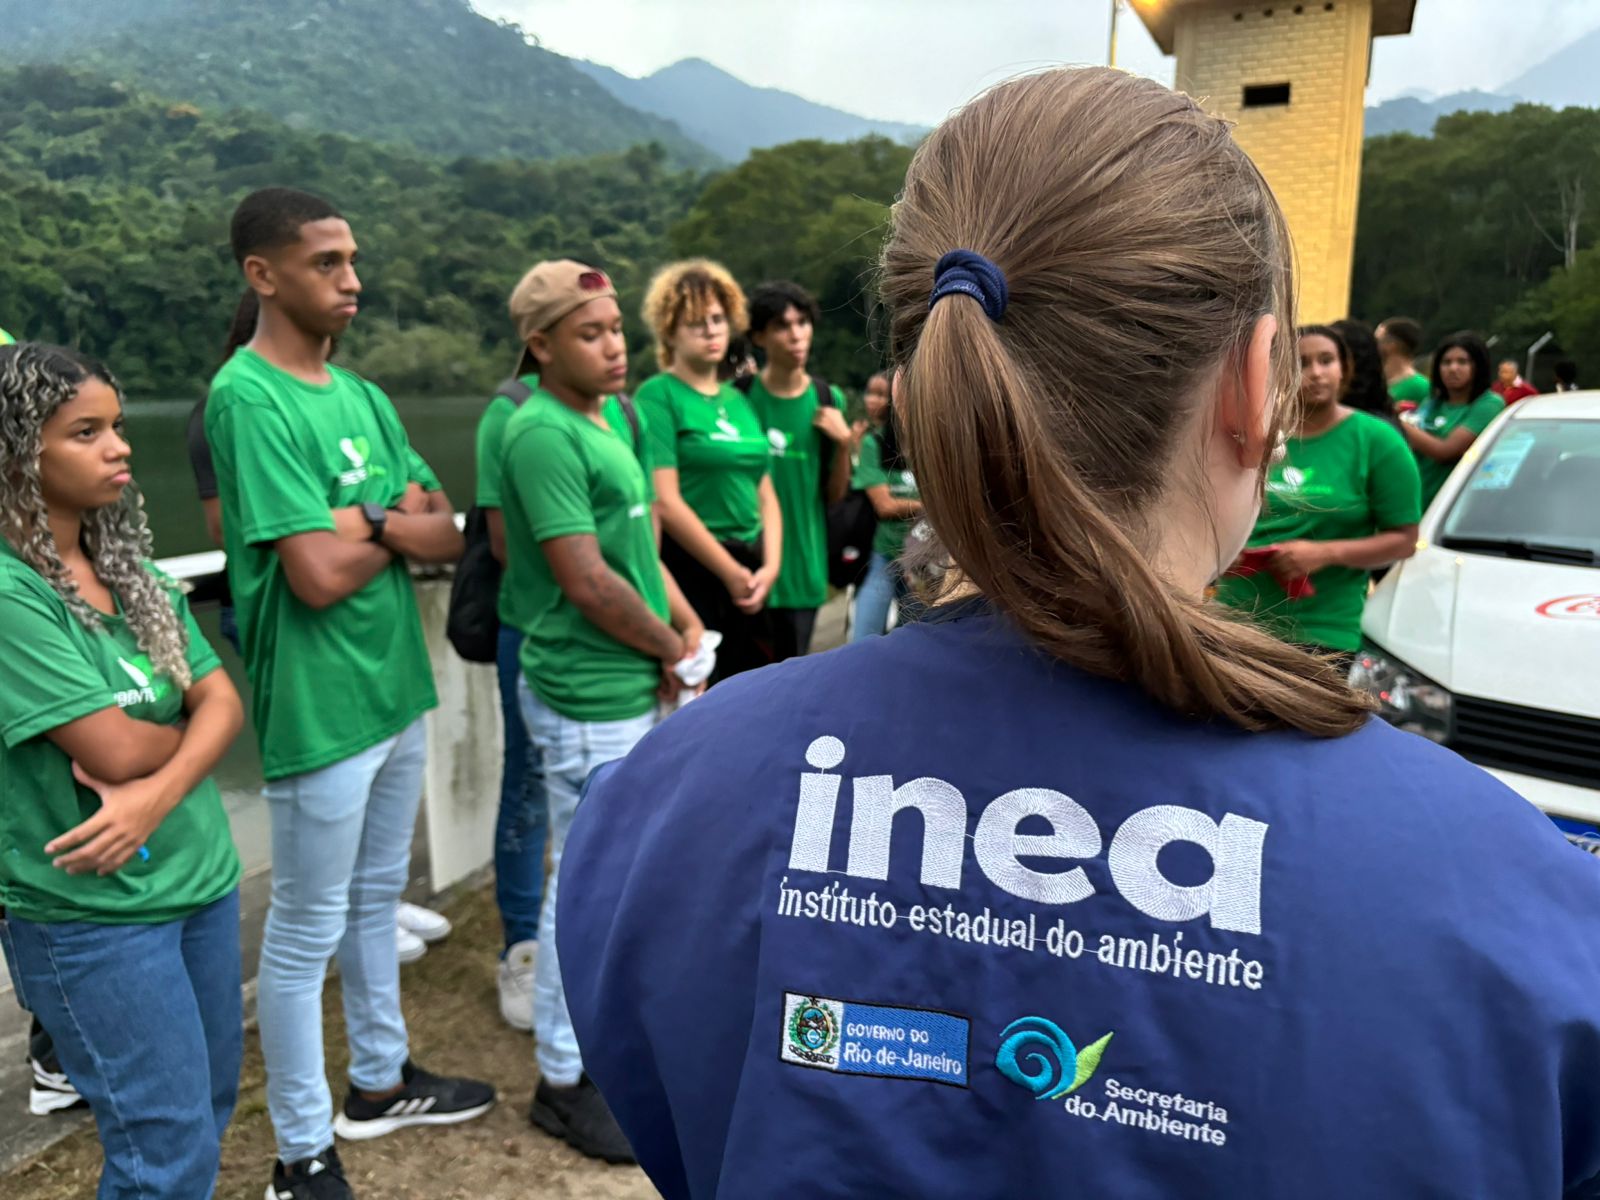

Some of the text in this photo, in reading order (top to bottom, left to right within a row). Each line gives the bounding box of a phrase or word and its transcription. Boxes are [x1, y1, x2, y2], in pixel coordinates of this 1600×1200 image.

[789, 735, 1269, 935] inea
[777, 876, 1264, 990] instituto estadual do ambiente
[846, 1023, 929, 1043] GOVERNO DO
[843, 1042, 962, 1075] Rio de Janeiro
[1065, 1095, 1227, 1146] do Ambiente
[1105, 1078, 1228, 1124] Secretaria
